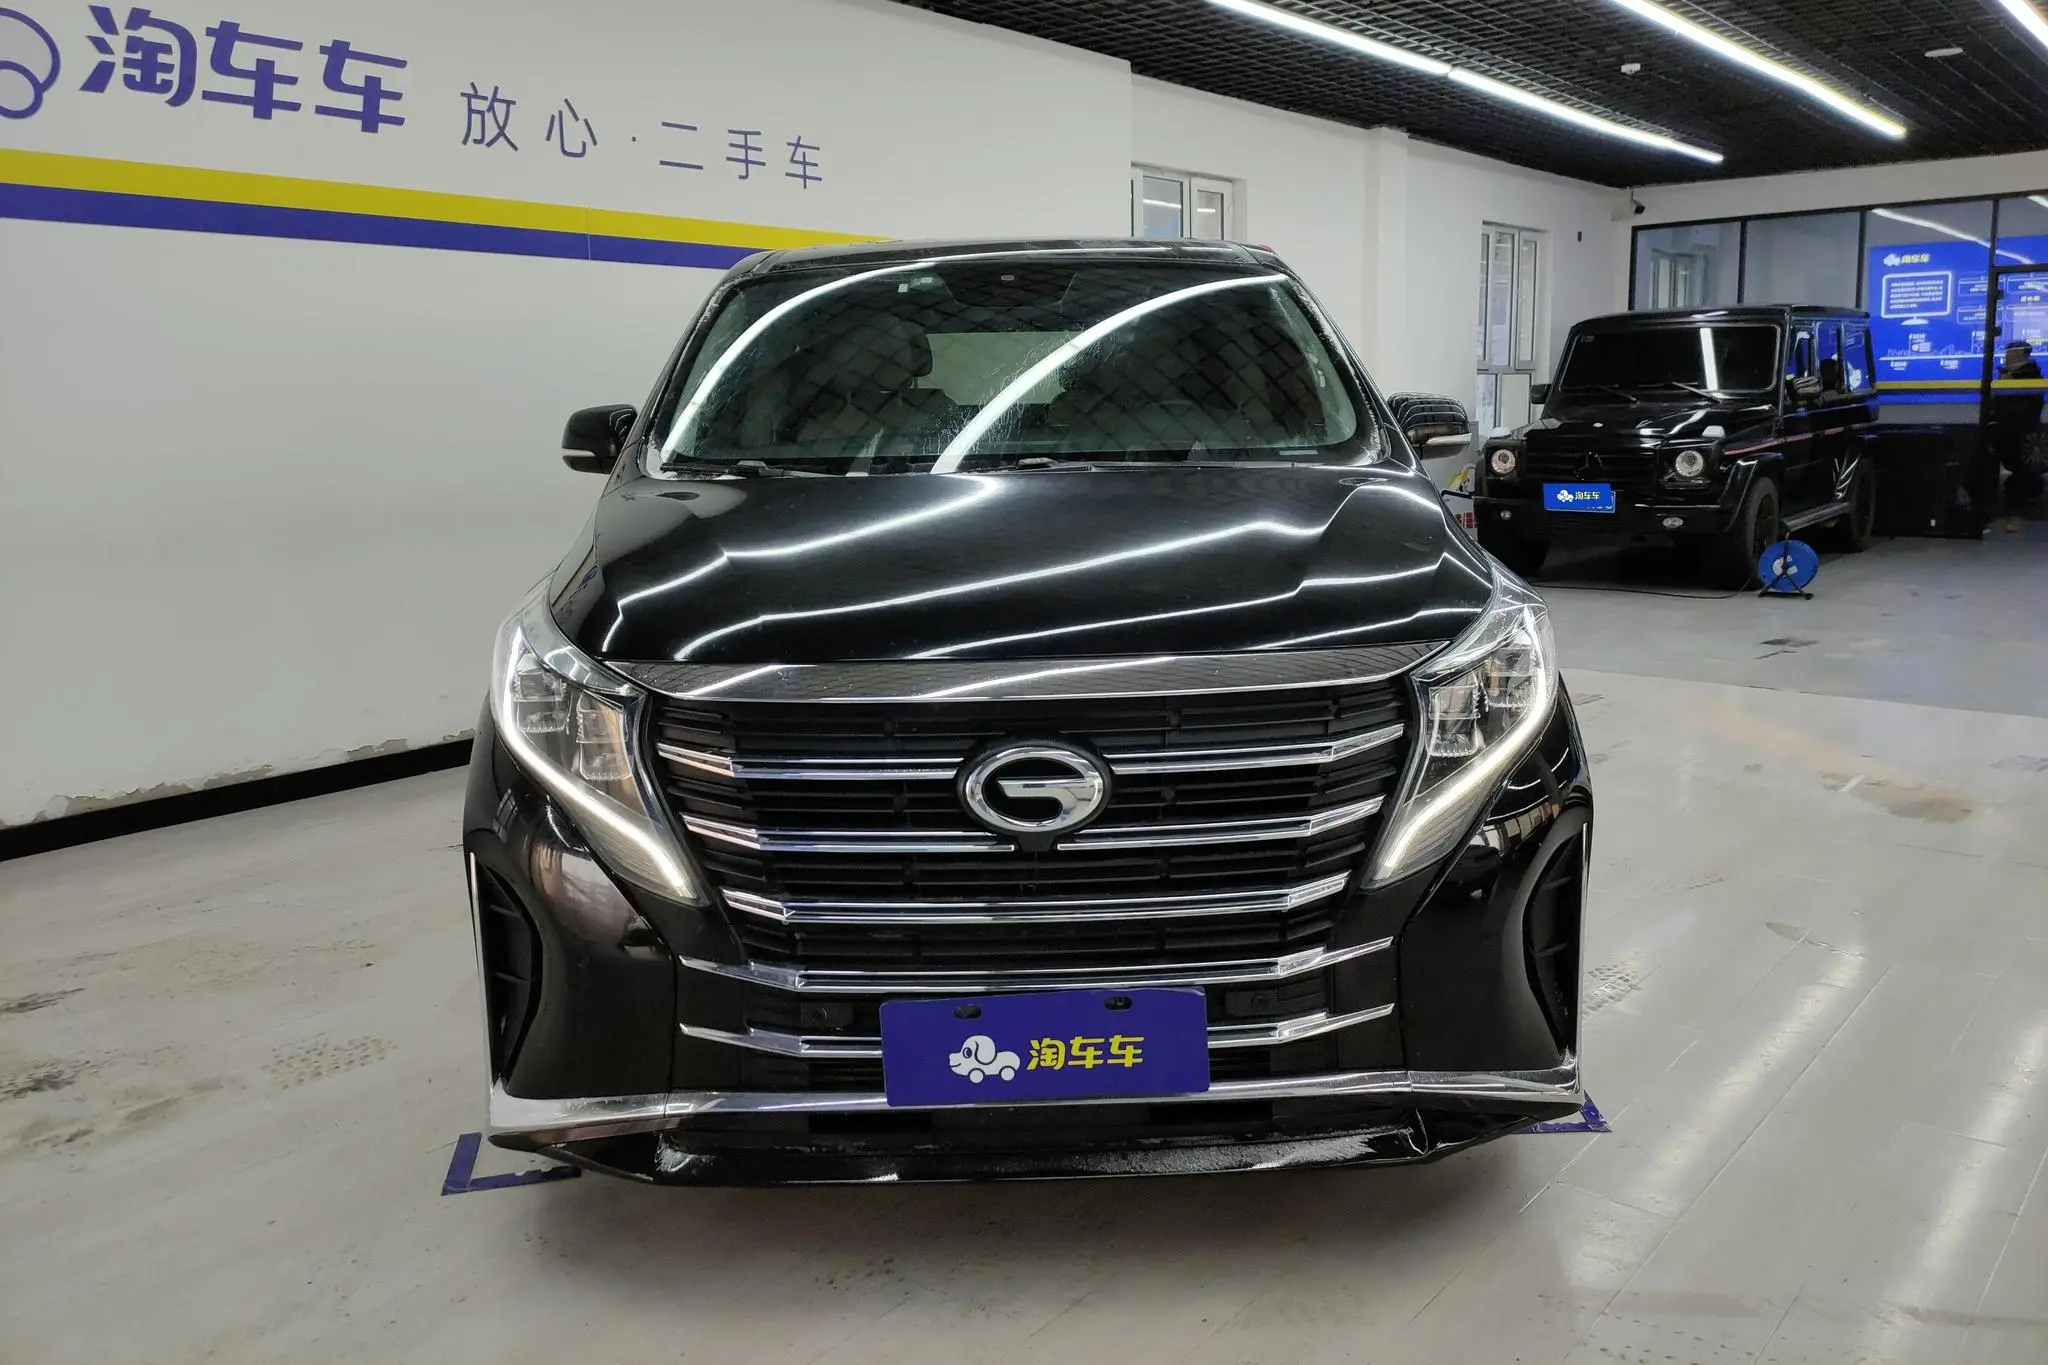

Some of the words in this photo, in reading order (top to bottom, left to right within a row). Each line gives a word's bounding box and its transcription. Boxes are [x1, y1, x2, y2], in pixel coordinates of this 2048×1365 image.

[80, 5, 408, 134] 淘车车
[1026, 1034, 1145, 1071] 淘车车
